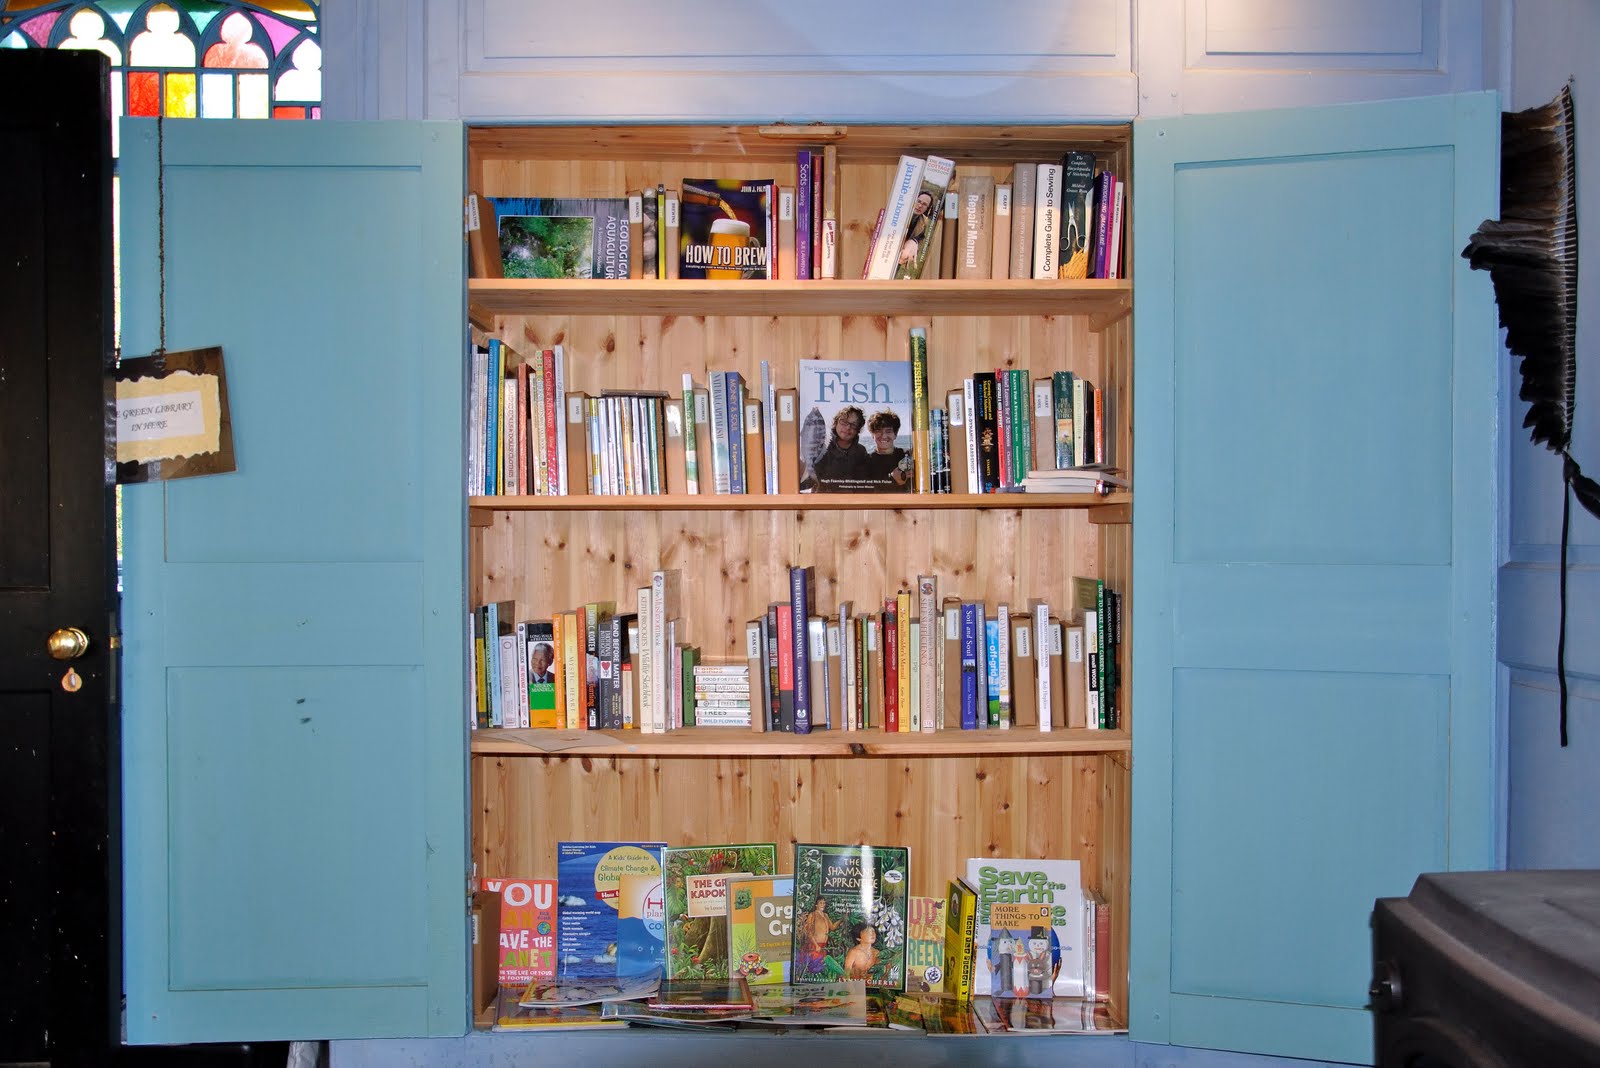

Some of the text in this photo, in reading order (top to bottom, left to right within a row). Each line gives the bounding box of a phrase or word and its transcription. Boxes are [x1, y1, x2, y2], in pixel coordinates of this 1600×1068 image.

[799, 164, 809, 186] Scots
[901, 162, 917, 195] jamie
[928, 163, 950, 173] COTTAGE
[798, 186, 806, 207] cooking
[890, 202, 905, 227] home
[1042, 168, 1056, 272] Complete Guide to Sewing
[965, 194, 979, 268] Repair Manual
[604, 215, 617, 280] AQUACULTUR
[685, 245, 767, 266] HOW TO BREW
[814, 371, 894, 404] Fish
[914, 361, 923, 399] FISHING
[729, 379, 738, 406] MONEY
[122, 406, 153, 420] GREEN
[154, 401, 194, 414] LIBRARY
[713, 373, 725, 440] NATURAL CAPITALISM
[1022, 394, 1030, 421] Gardening
[131, 420, 168, 431] IN HERE
[640, 596, 648, 613] KEITH
[654, 598, 663, 633] Mushroom
[612, 619, 620, 637] MIND
[965, 610, 974, 656] Soil and Soul
[899, 619, 909, 680] Smallholder's Manual
[641, 649, 651, 673] Wildlife
[989, 645, 999, 677] off-grid
[642, 674, 651, 709] Sketchbook
[625, 865, 649, 873] Change
[843, 858, 860, 867] THE
[693, 879, 712, 889] THE
[979, 866, 1048, 886] Save
[487, 881, 553, 910] YOU
[691, 888, 725, 899] KAPOK
[980, 885, 1054, 904] Earth
[503, 910, 534, 929] AN
[760, 902, 794, 919] Org
[909, 898, 938, 926] UD
[994, 913, 1041, 921] THINGS TO
[769, 920, 794, 936] Cr
[909, 923, 943, 943] OES
[500, 930, 529, 950] AVE
[533, 936, 553, 948] THE
[500, 949, 553, 969] ANET
[908, 940, 944, 967] REEN
